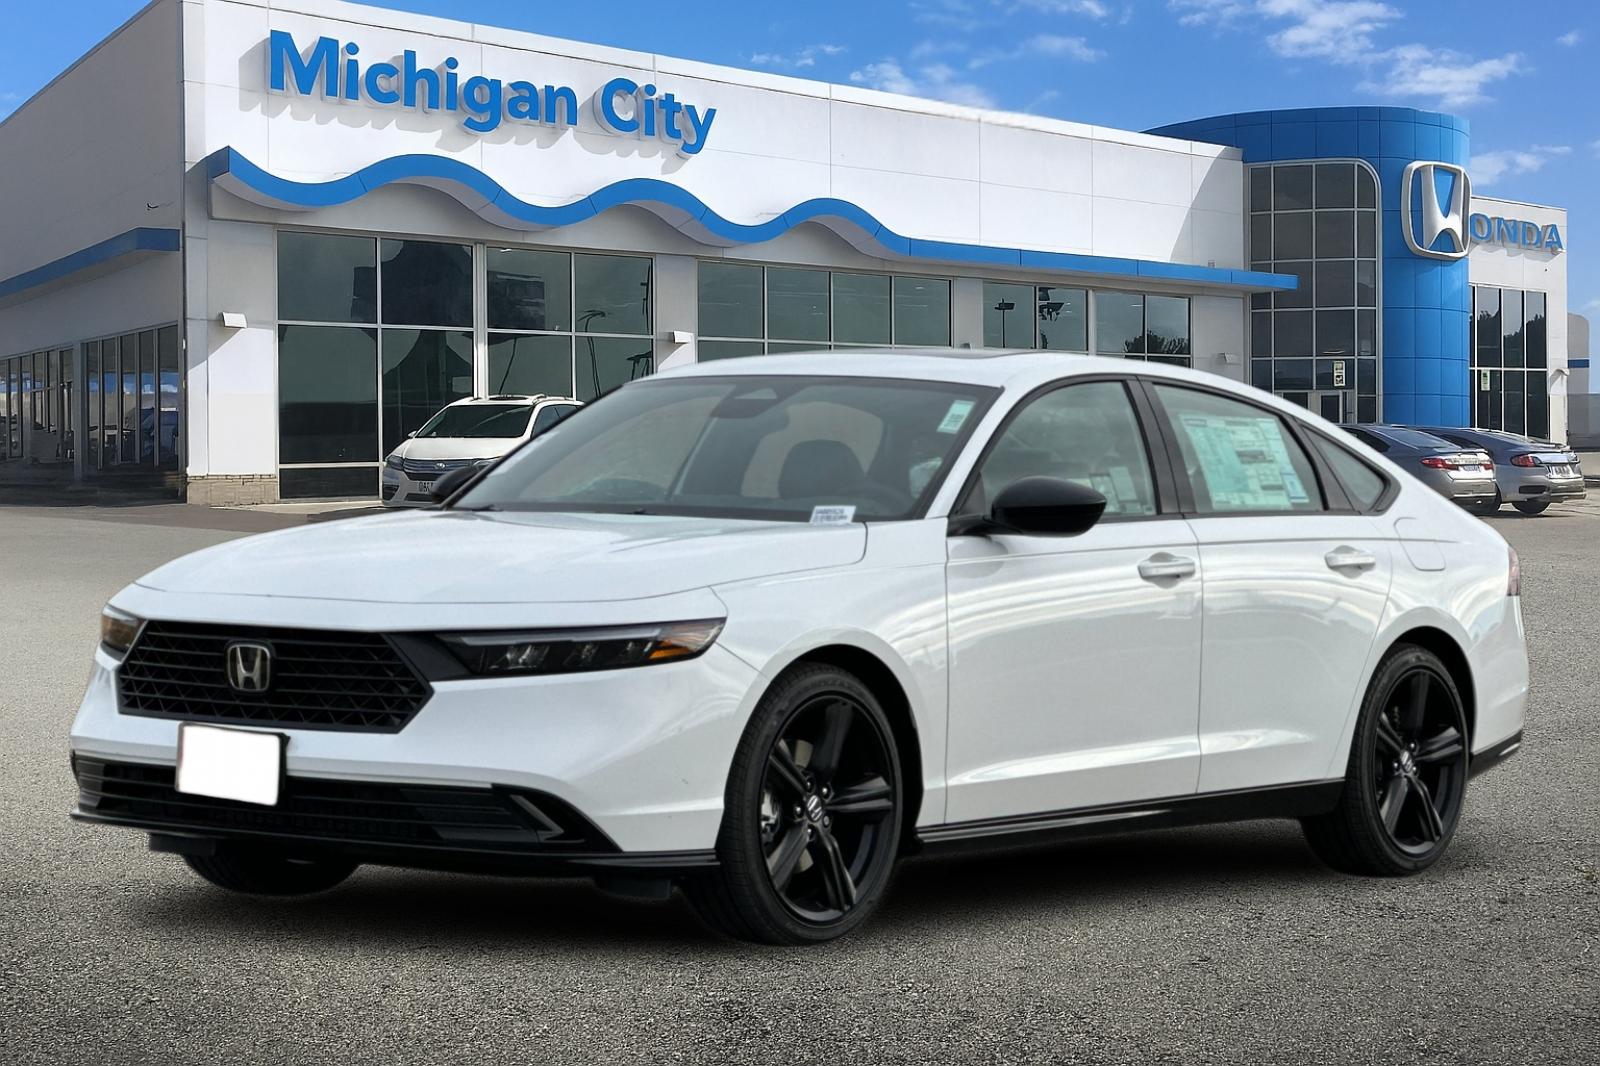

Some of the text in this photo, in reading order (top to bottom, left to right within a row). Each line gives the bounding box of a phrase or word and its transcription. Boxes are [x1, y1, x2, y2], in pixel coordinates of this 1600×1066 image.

[269, 29, 717, 154] Michigan City
[1469, 212, 1564, 251] ONDA
